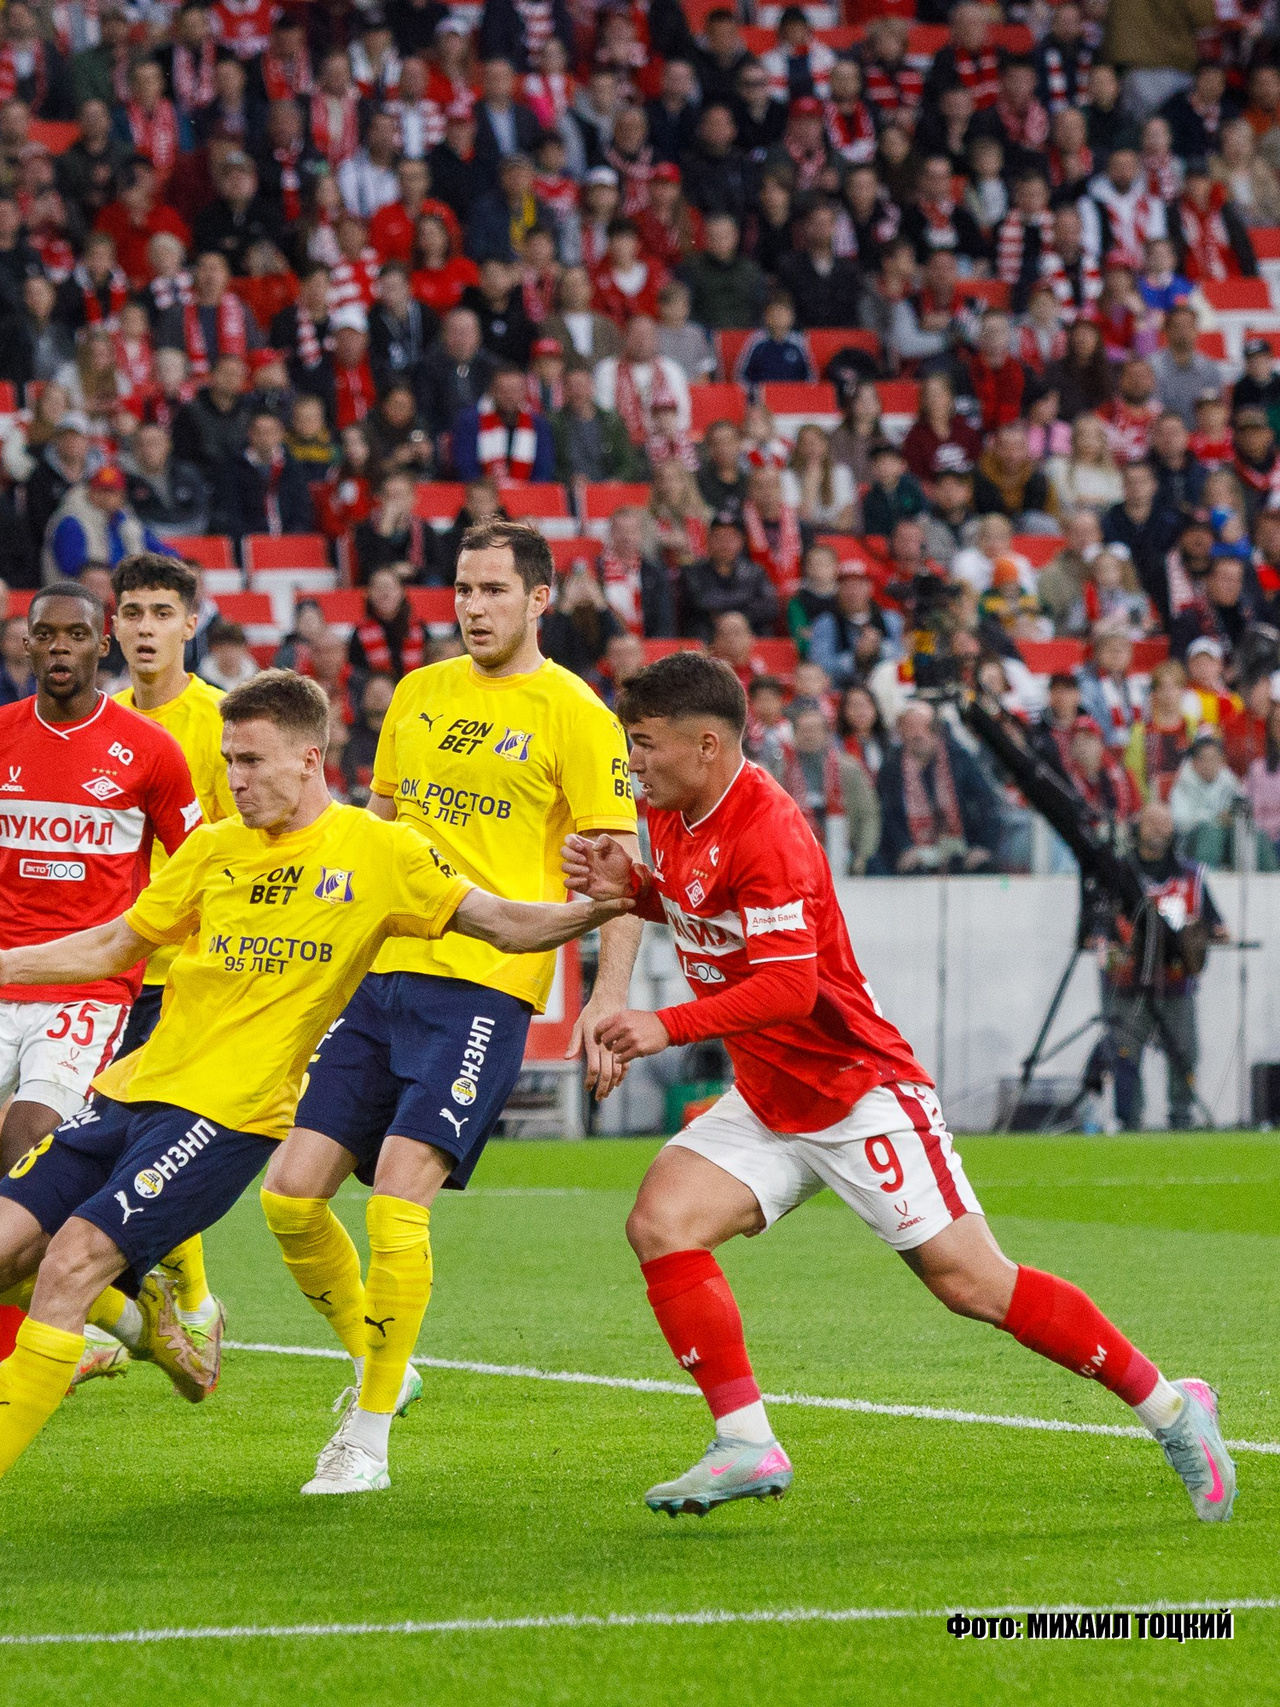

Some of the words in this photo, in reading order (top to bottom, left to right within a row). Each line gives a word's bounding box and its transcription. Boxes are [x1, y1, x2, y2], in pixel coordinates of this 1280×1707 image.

[447, 719, 494, 738] FON
[108, 741, 134, 766] BQ
[437, 734, 483, 756] BET
[611, 758, 629, 776] FO
[401, 778, 421, 797] ФК
[425, 782, 512, 819] РОСТОВ
[614, 779, 632, 800] BE
[416, 799, 430, 816] 5
[434, 806, 471, 827] ЛЕТ
[47, 863, 83, 879] 100
[249, 885, 298, 905] BET
[752, 915, 776, 928] Альфа
[777, 913, 799, 922] Банк
[238, 936, 333, 963] РОСТОВ
[224, 955, 246, 972] 95
[249, 957, 289, 975] ЛЕТ
[8, 1133, 55, 1179] 8
[864, 1134, 904, 1193] 9
